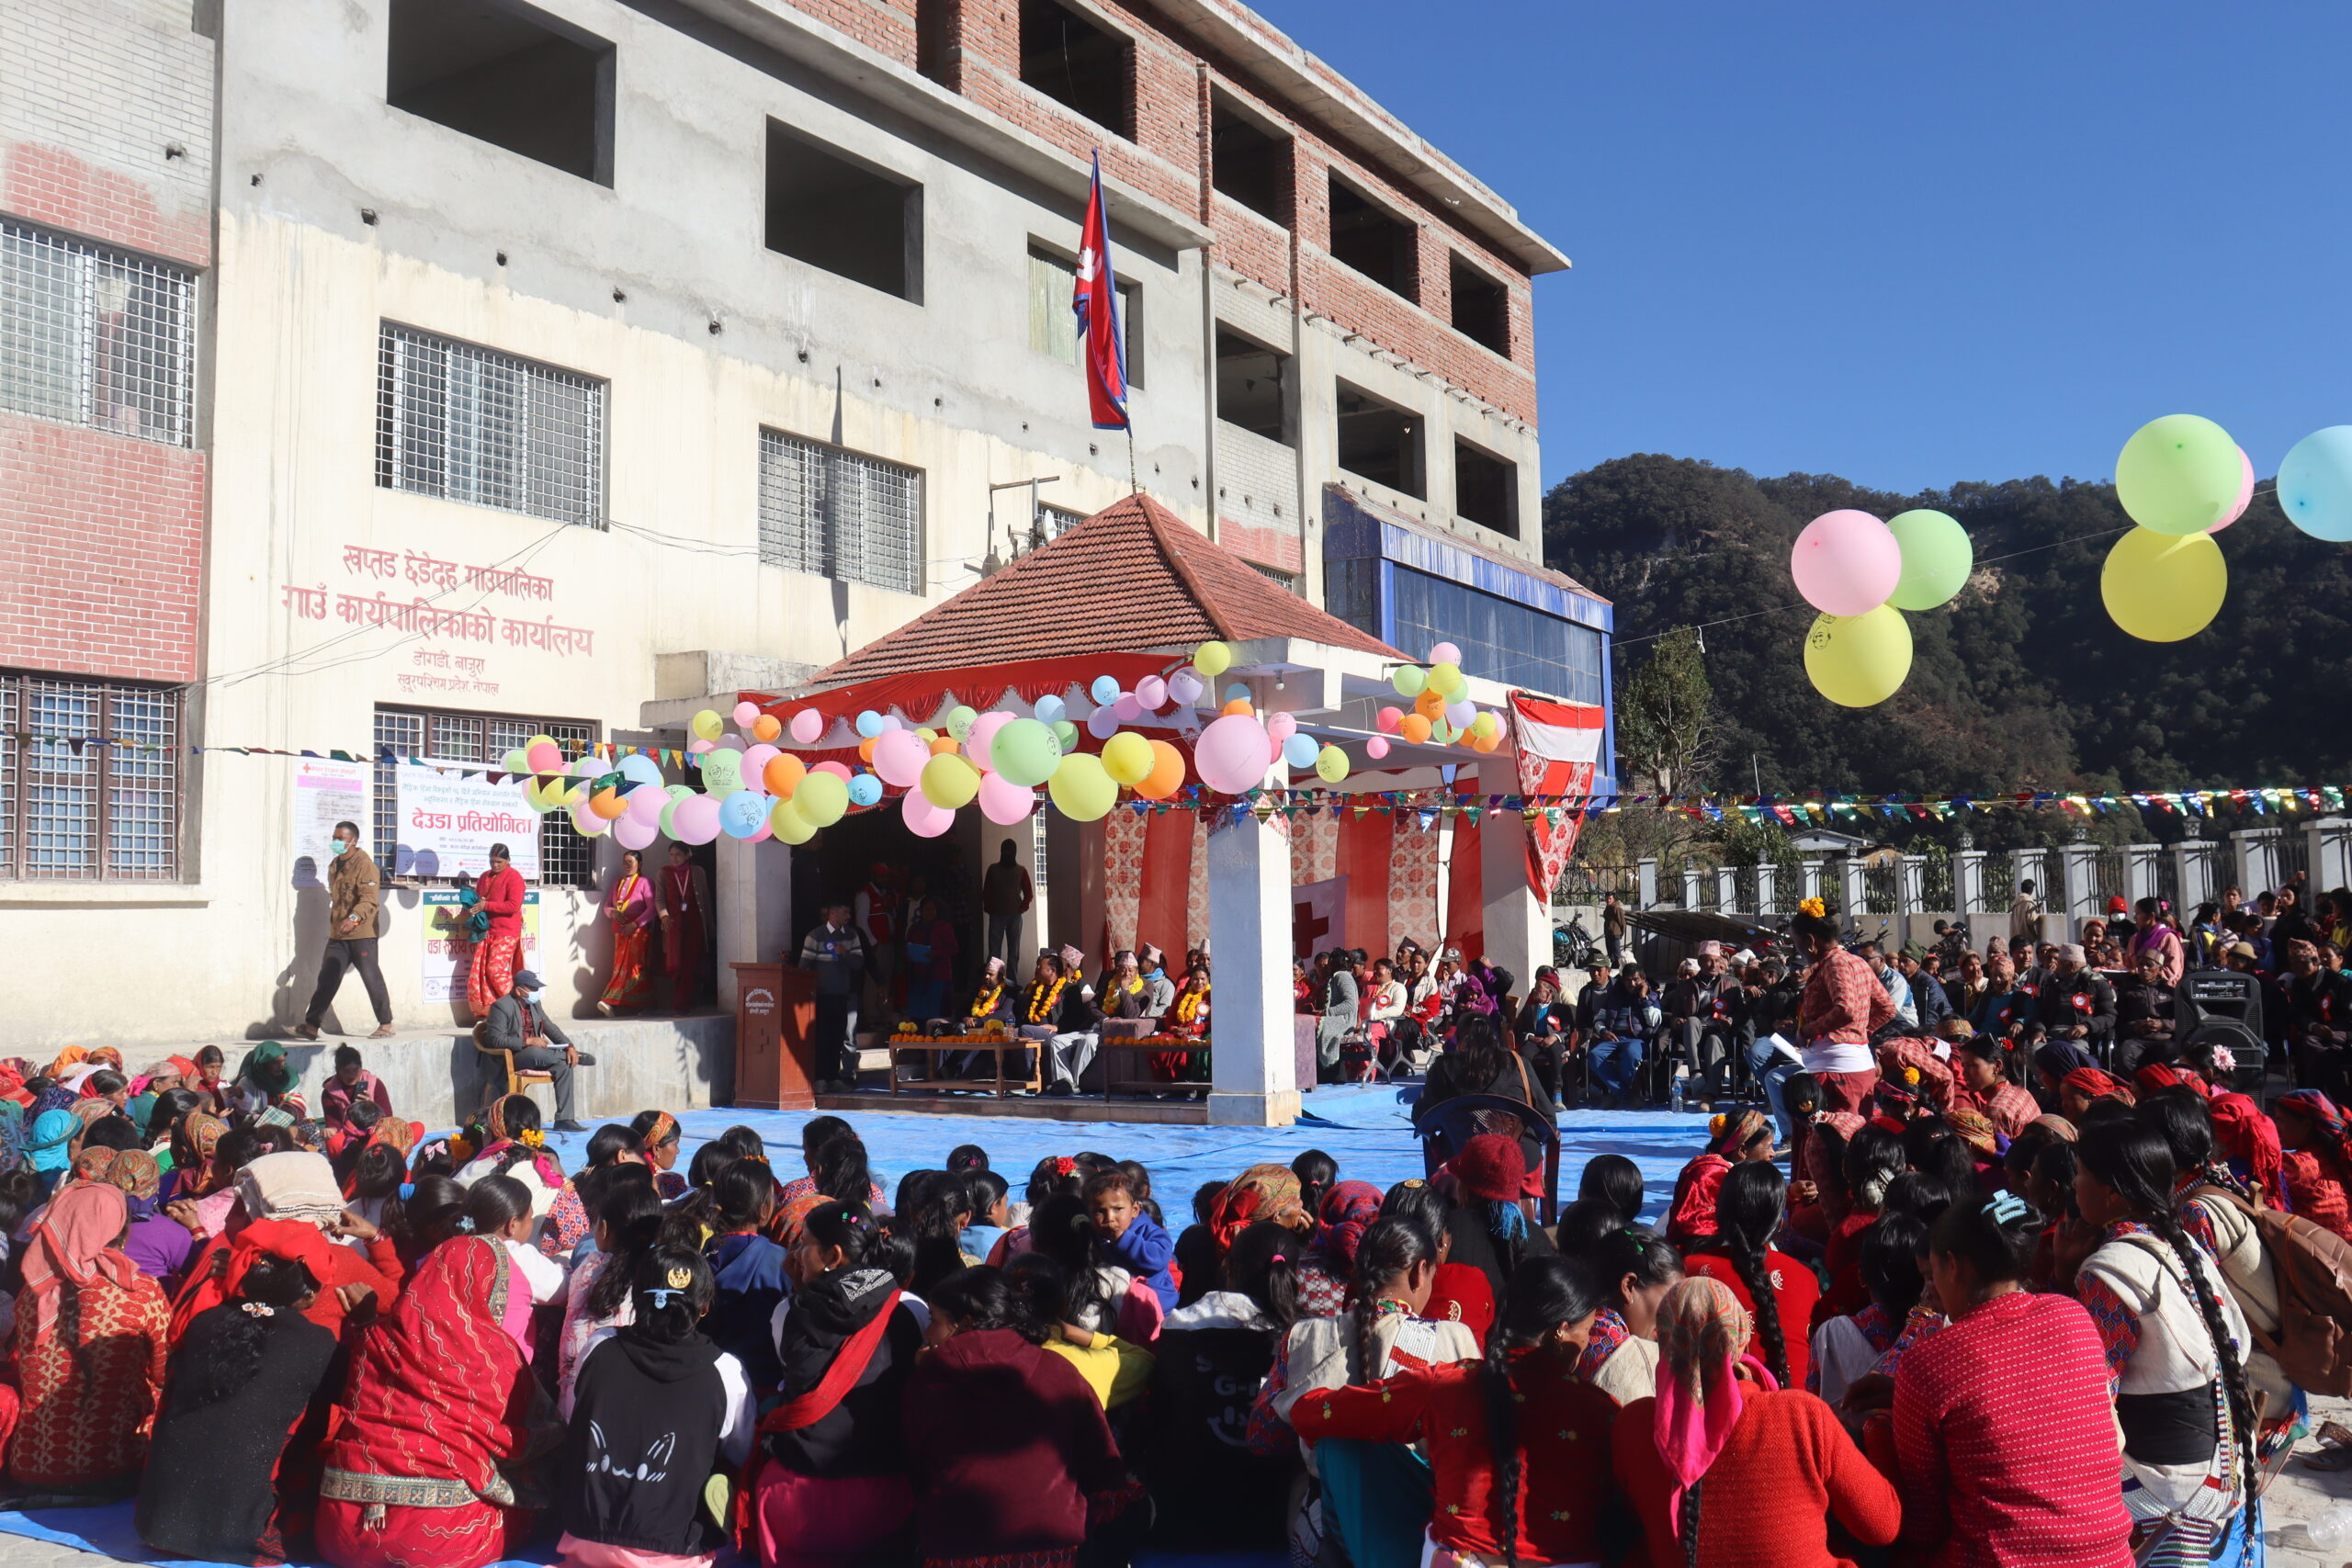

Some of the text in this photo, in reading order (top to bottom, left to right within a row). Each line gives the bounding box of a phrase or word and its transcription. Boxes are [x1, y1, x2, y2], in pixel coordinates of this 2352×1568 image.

[343, 545, 398, 580] खप्तड
[404, 548, 458, 592] छेडेदह
[281, 581, 594, 658] गाउँ कार्यपालिकाको कार्यालय
[455, 656, 485, 677] बाजुरा
[473, 678, 500, 695] नेपाल
[412, 807, 532, 834] देउडा प्रतियोगिता
[427, 940, 442, 954] वडा
